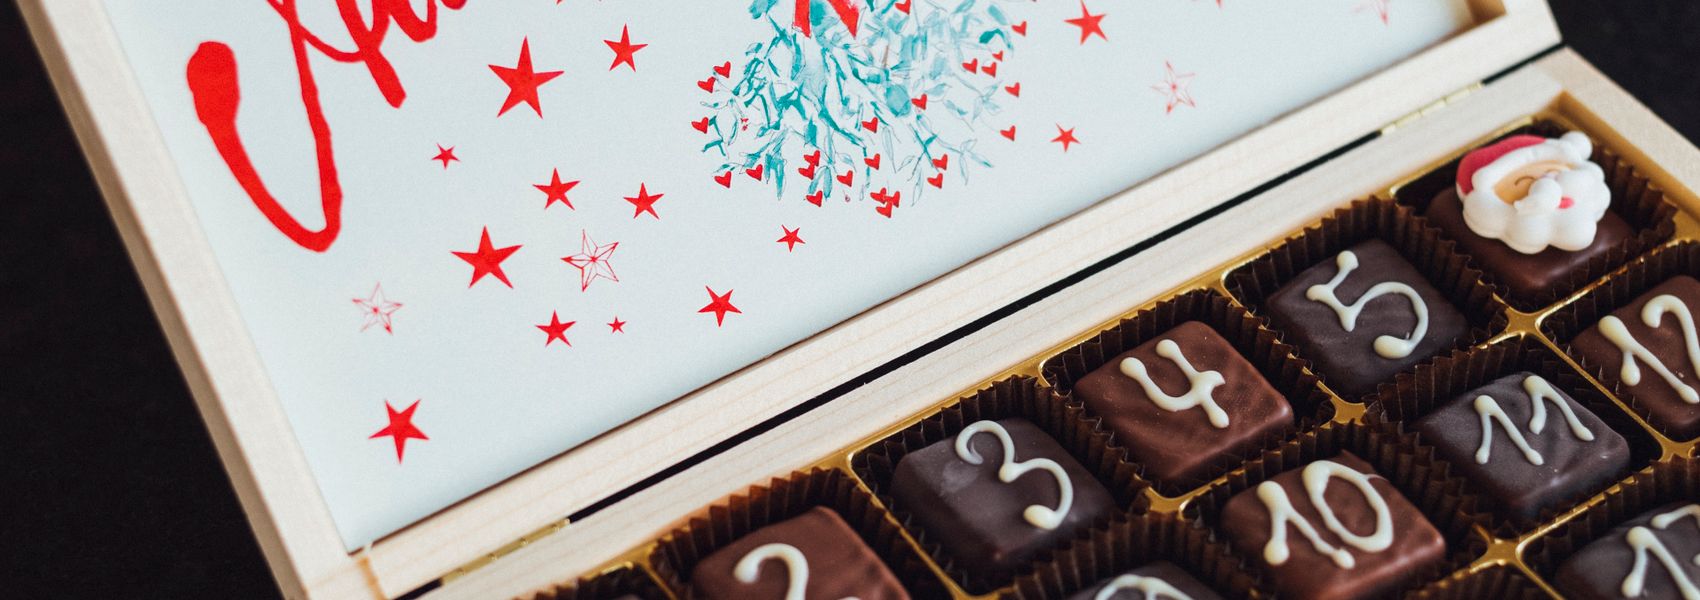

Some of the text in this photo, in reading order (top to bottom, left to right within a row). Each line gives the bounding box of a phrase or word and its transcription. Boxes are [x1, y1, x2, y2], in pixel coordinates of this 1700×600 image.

[1305, 250, 1430, 359] 5
[1120, 339, 1230, 430] 4
[955, 419, 1074, 530] 3
[1257, 459, 1396, 570] 10
